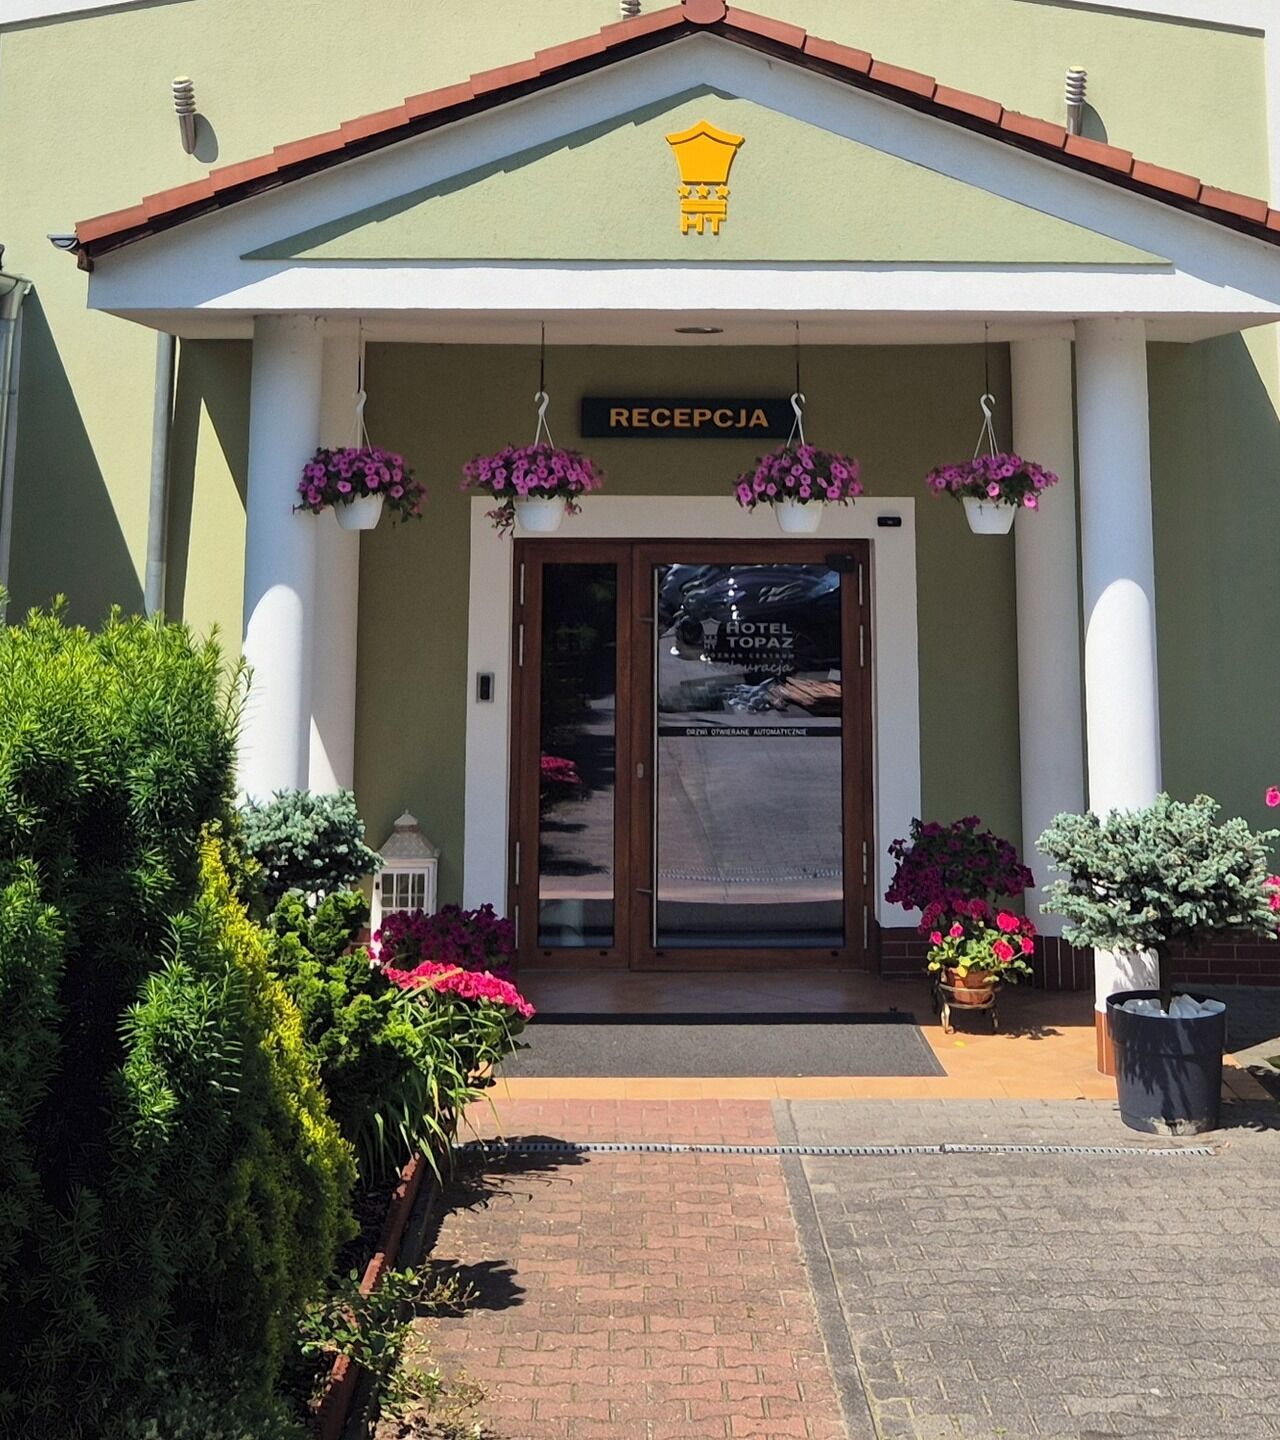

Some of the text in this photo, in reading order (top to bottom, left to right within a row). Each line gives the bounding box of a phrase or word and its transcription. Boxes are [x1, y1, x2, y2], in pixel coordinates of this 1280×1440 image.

[681, 214, 727, 235] HT
[609, 408, 769, 428] RECEPCJA
[726, 622, 792, 634] HOTEL
[726, 636, 793, 649] TOPAZ
